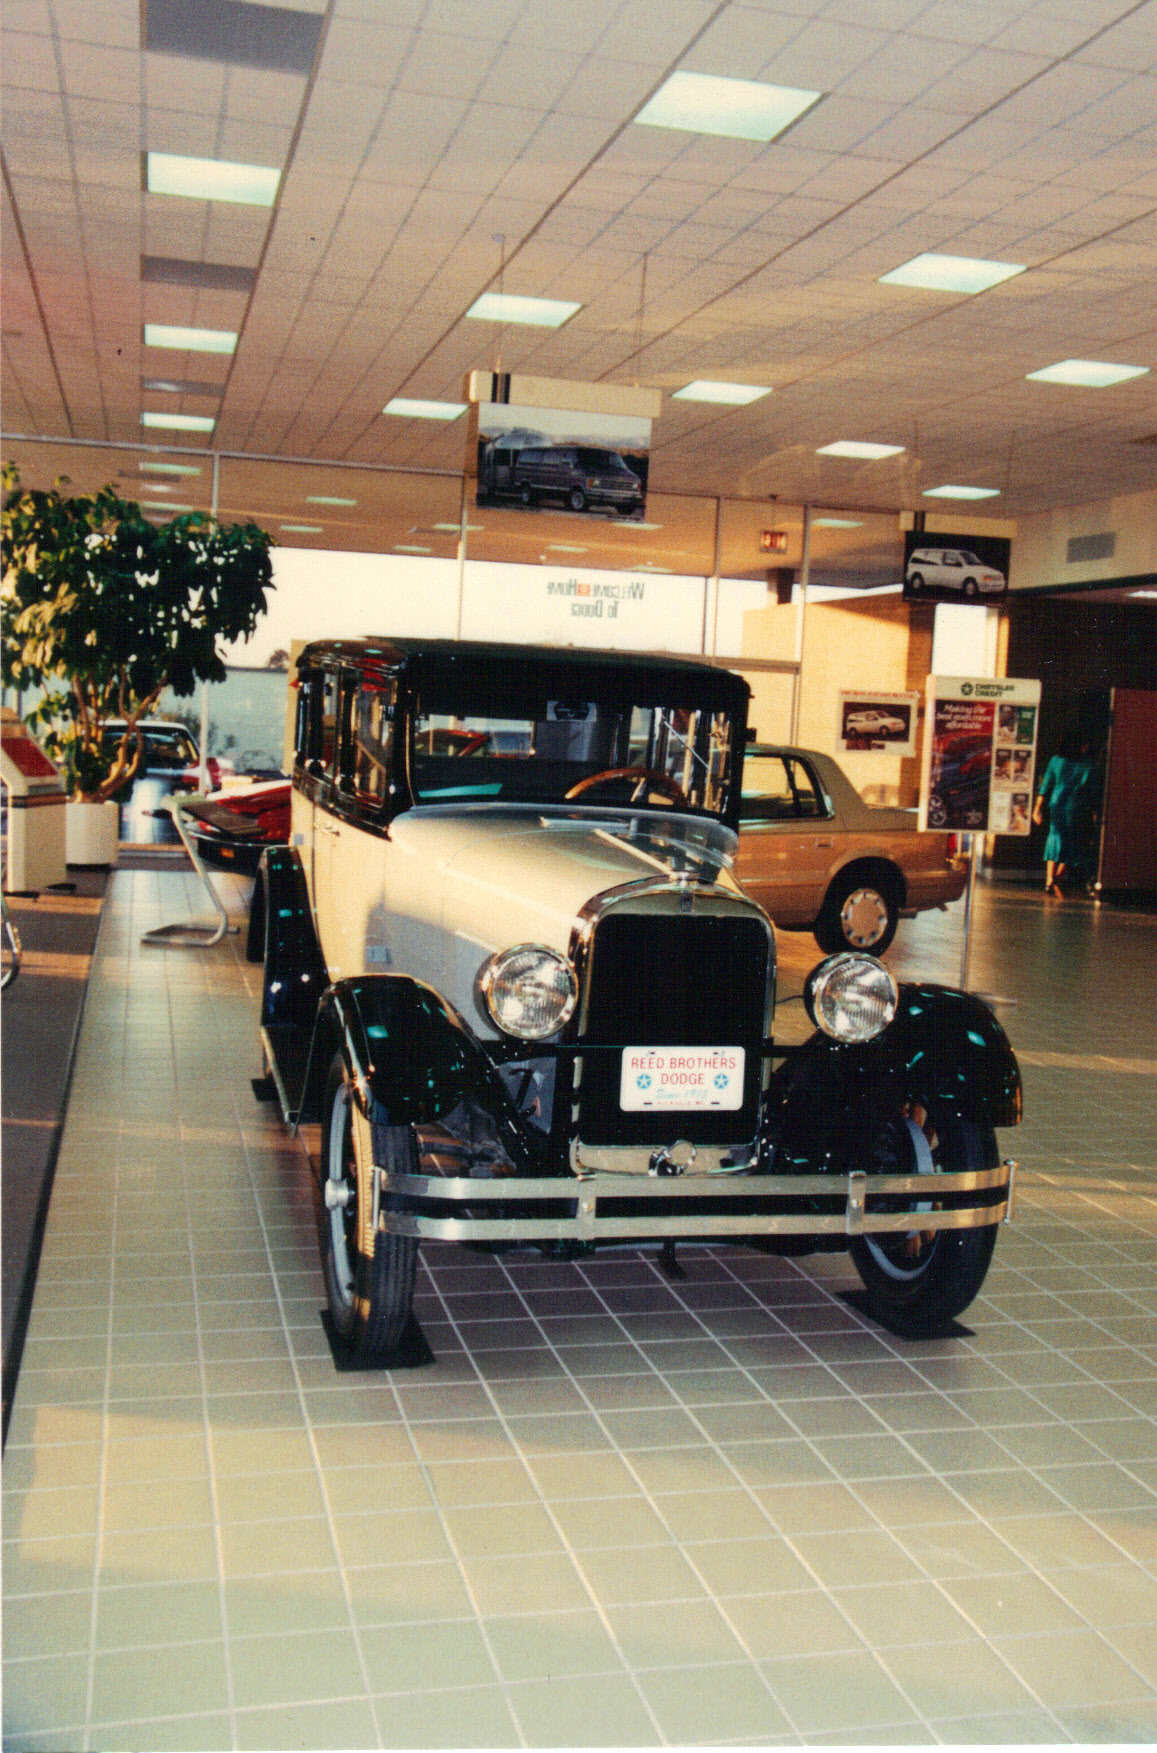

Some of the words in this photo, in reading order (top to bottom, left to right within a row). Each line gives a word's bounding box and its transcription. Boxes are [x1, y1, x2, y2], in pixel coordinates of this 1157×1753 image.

[975, 683, 1015, 691] CHRYSLER
[631, 1057, 665, 1069] REED
[669, 1057, 736, 1069] BROTHERS
[660, 1073, 705, 1085] DODGE
